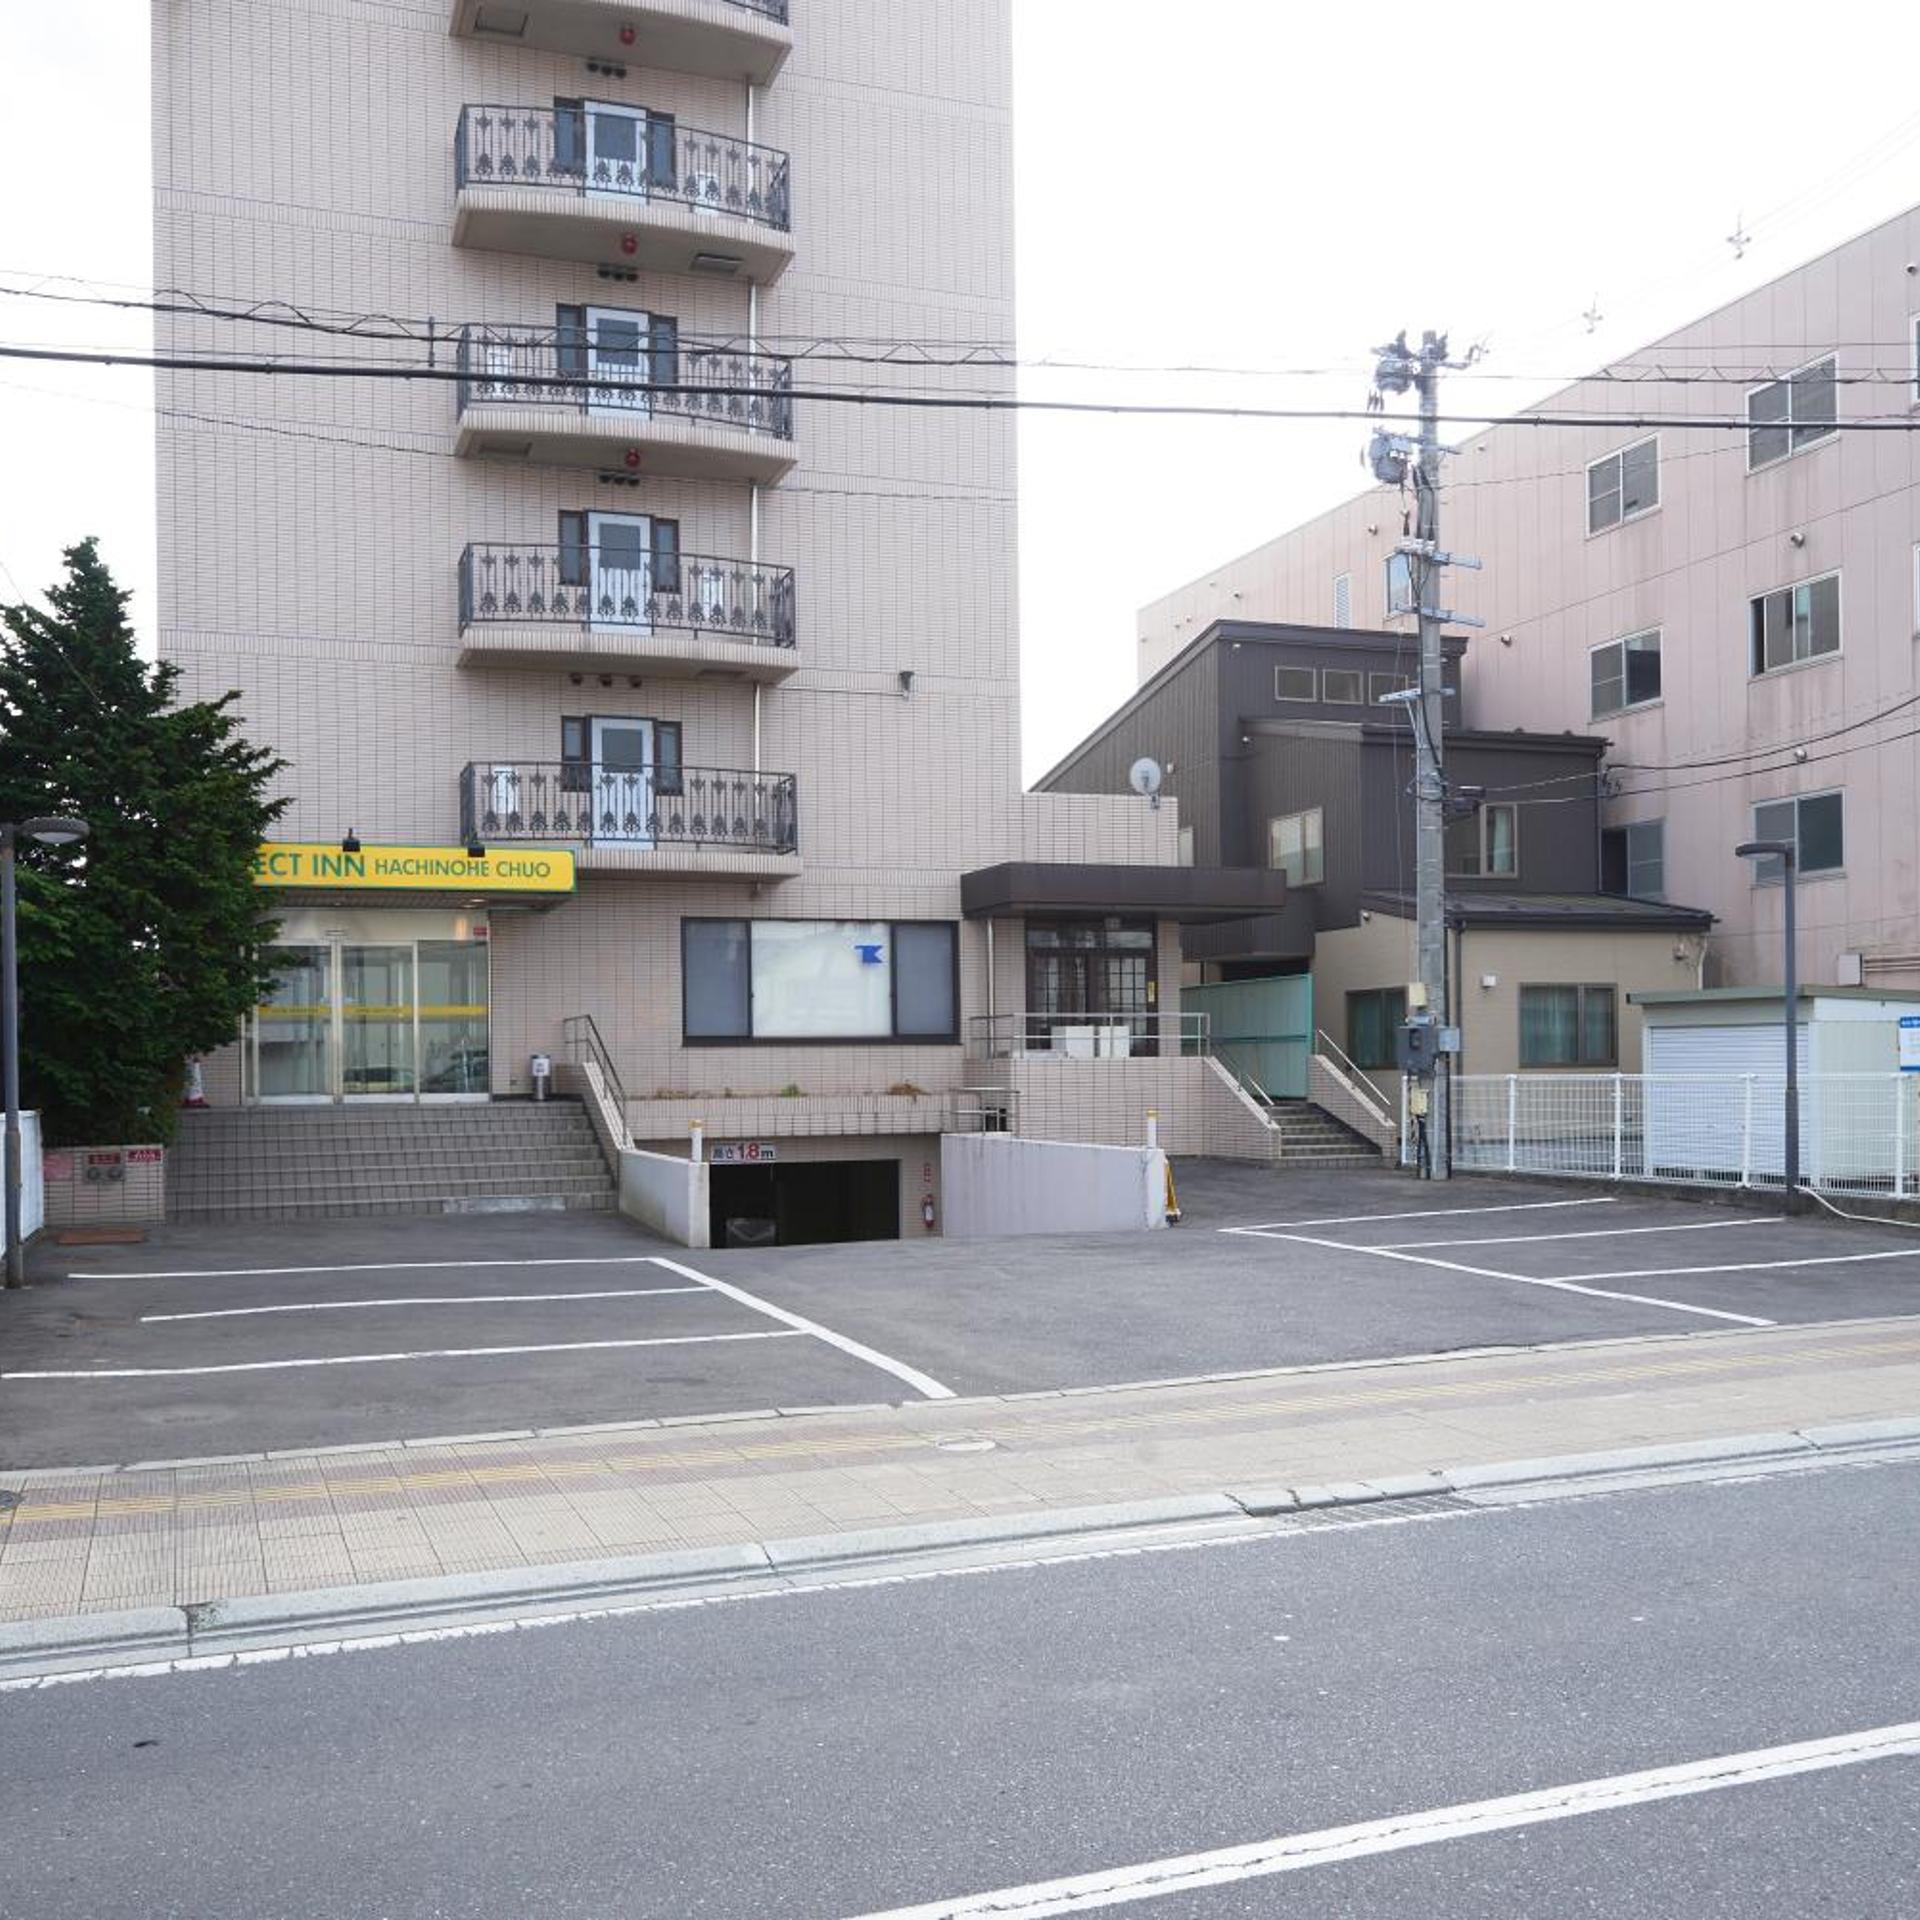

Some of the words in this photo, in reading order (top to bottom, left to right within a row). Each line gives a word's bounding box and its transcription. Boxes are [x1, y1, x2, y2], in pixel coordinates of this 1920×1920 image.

[312, 853, 365, 877] INN
[375, 858, 490, 878] HACHINOHE
[496, 860, 551, 878] CHUO
